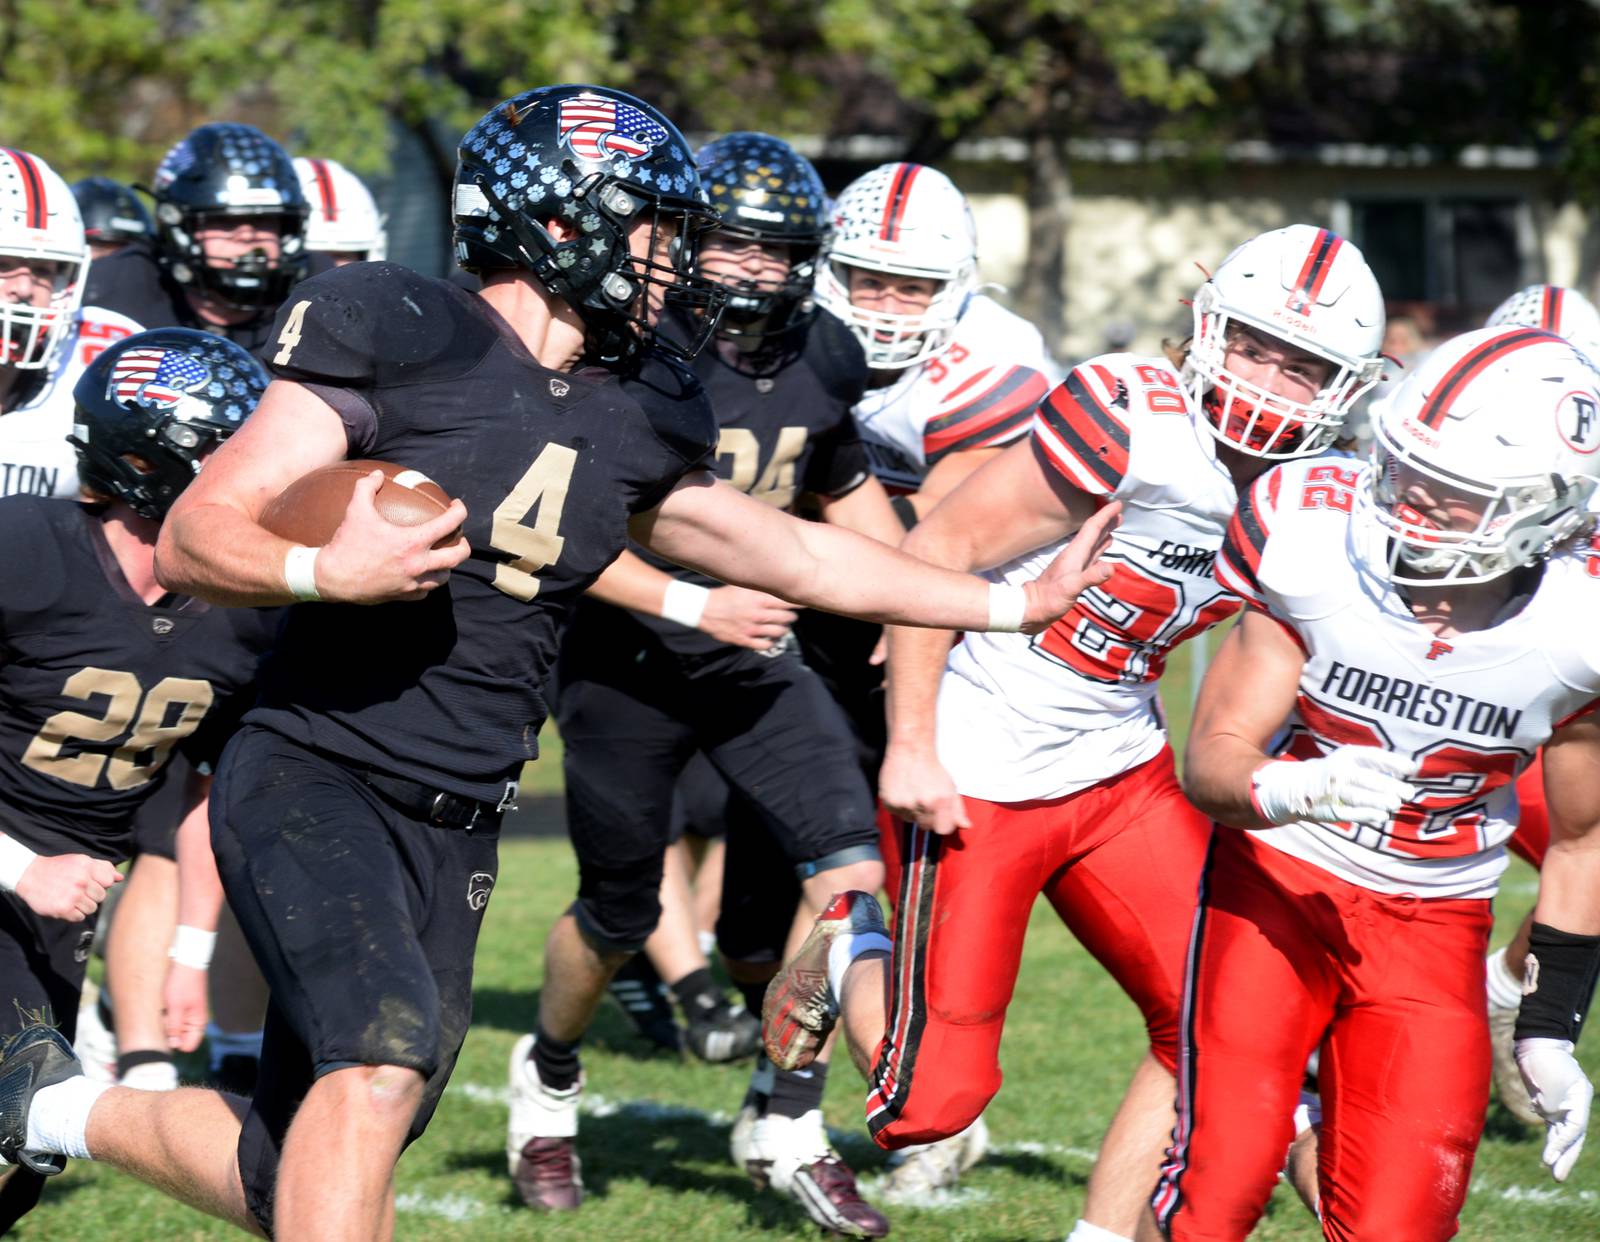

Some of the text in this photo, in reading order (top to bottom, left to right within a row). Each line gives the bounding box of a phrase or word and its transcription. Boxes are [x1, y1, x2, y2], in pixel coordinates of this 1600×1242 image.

[273, 300, 312, 366] 4
[1131, 363, 1189, 417] 20
[1570, 396, 1597, 444] F
[1299, 464, 1360, 516] 22
[490, 442, 578, 602] 4
[1425, 639, 1454, 661] F
[20, 666, 215, 791] 28
[1321, 660, 1523, 740] FORRESTON
